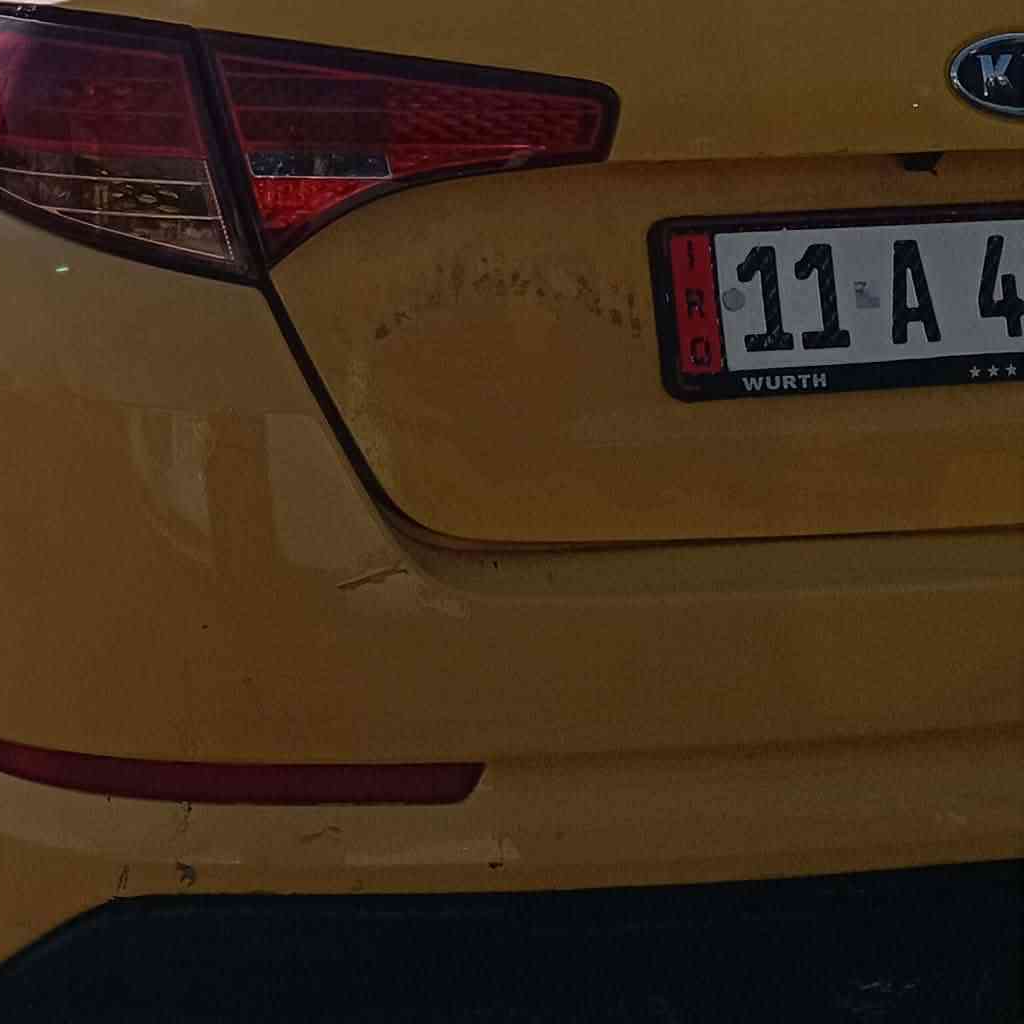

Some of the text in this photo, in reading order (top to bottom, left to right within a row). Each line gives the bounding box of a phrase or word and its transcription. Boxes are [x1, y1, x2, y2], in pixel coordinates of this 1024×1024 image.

[737, 243, 851, 352] 11
[892, 239, 942, 344] A
[742, 373, 828, 392] WURTH
